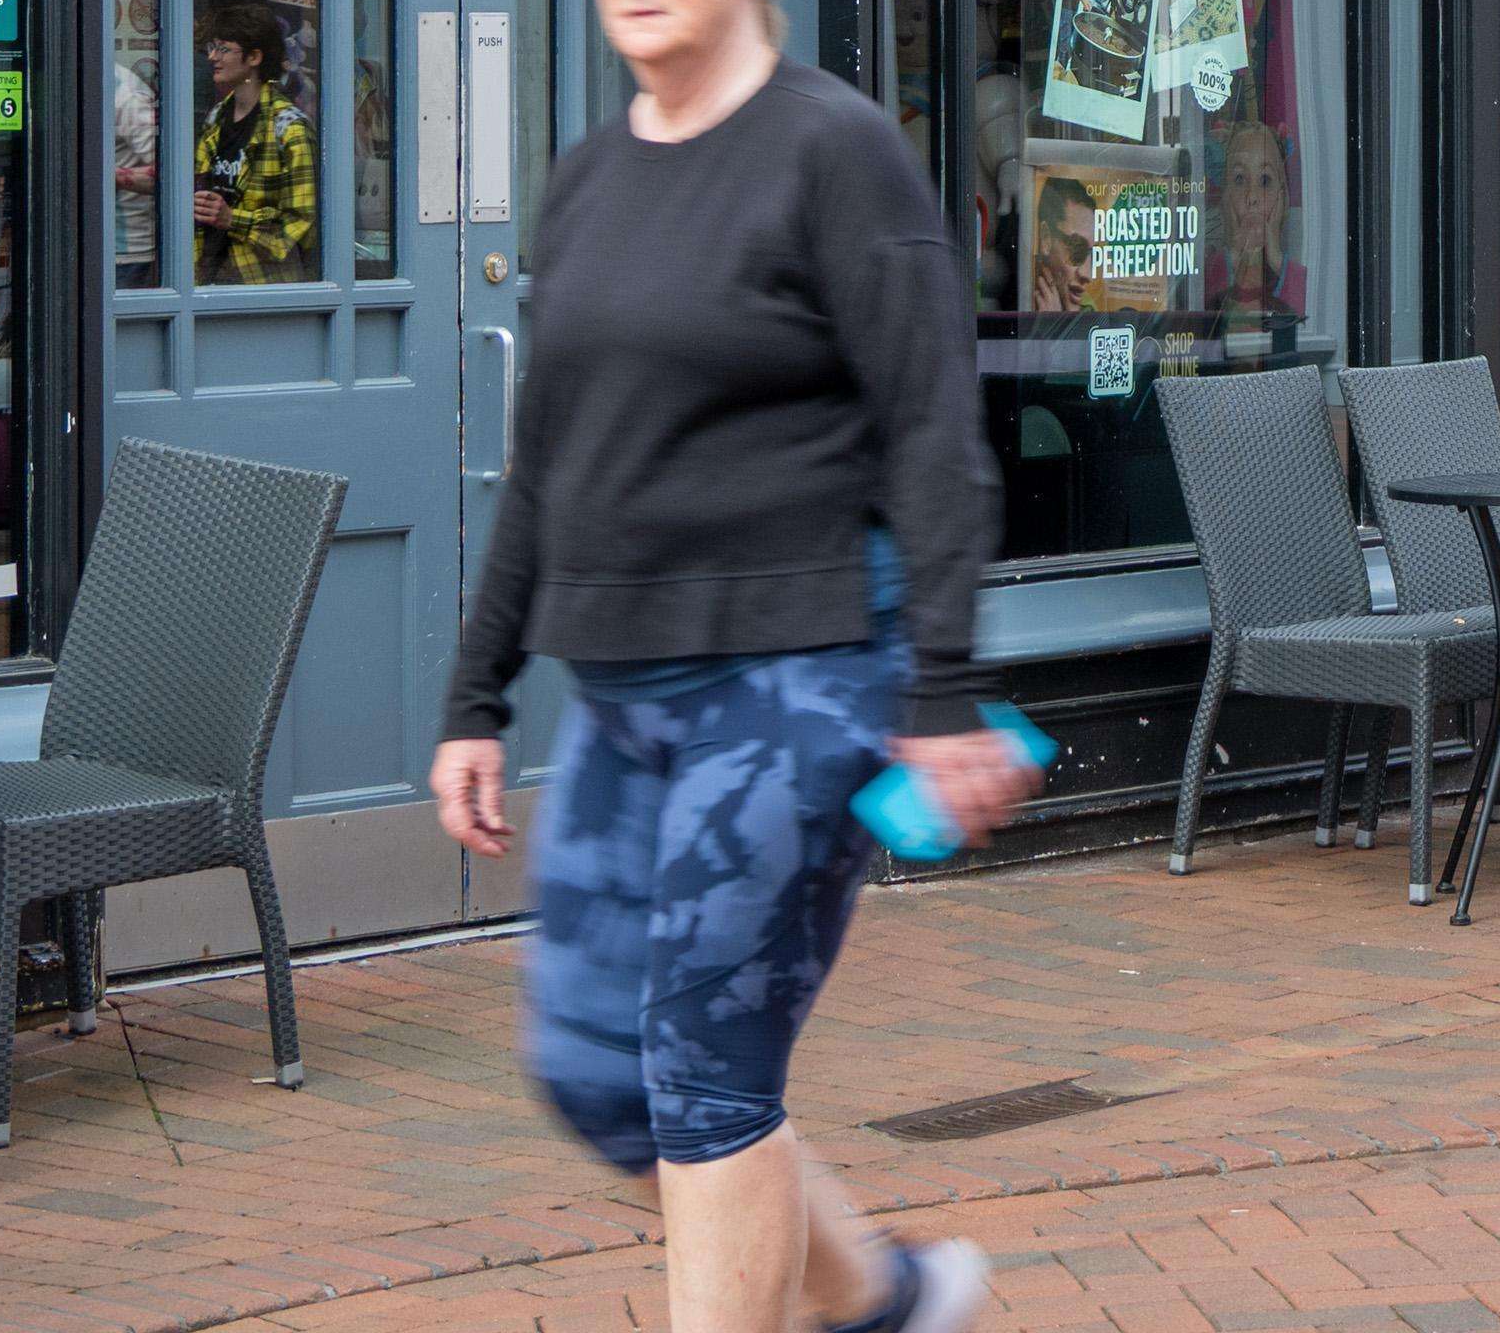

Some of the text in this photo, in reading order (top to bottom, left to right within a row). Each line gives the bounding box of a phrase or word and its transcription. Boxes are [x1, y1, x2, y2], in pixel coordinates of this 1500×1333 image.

[478, 36, 503, 47] PUSH
[1198, 71, 1226, 92] 100%
[1085, 176, 1206, 200] our signature blend
[1093, 205, 1198, 242] ROASTED TO
[1091, 242, 1199, 279] PERFECTION.
[1164, 332, 1194, 355] SHOP
[1160, 355, 1200, 377] ONLINE
